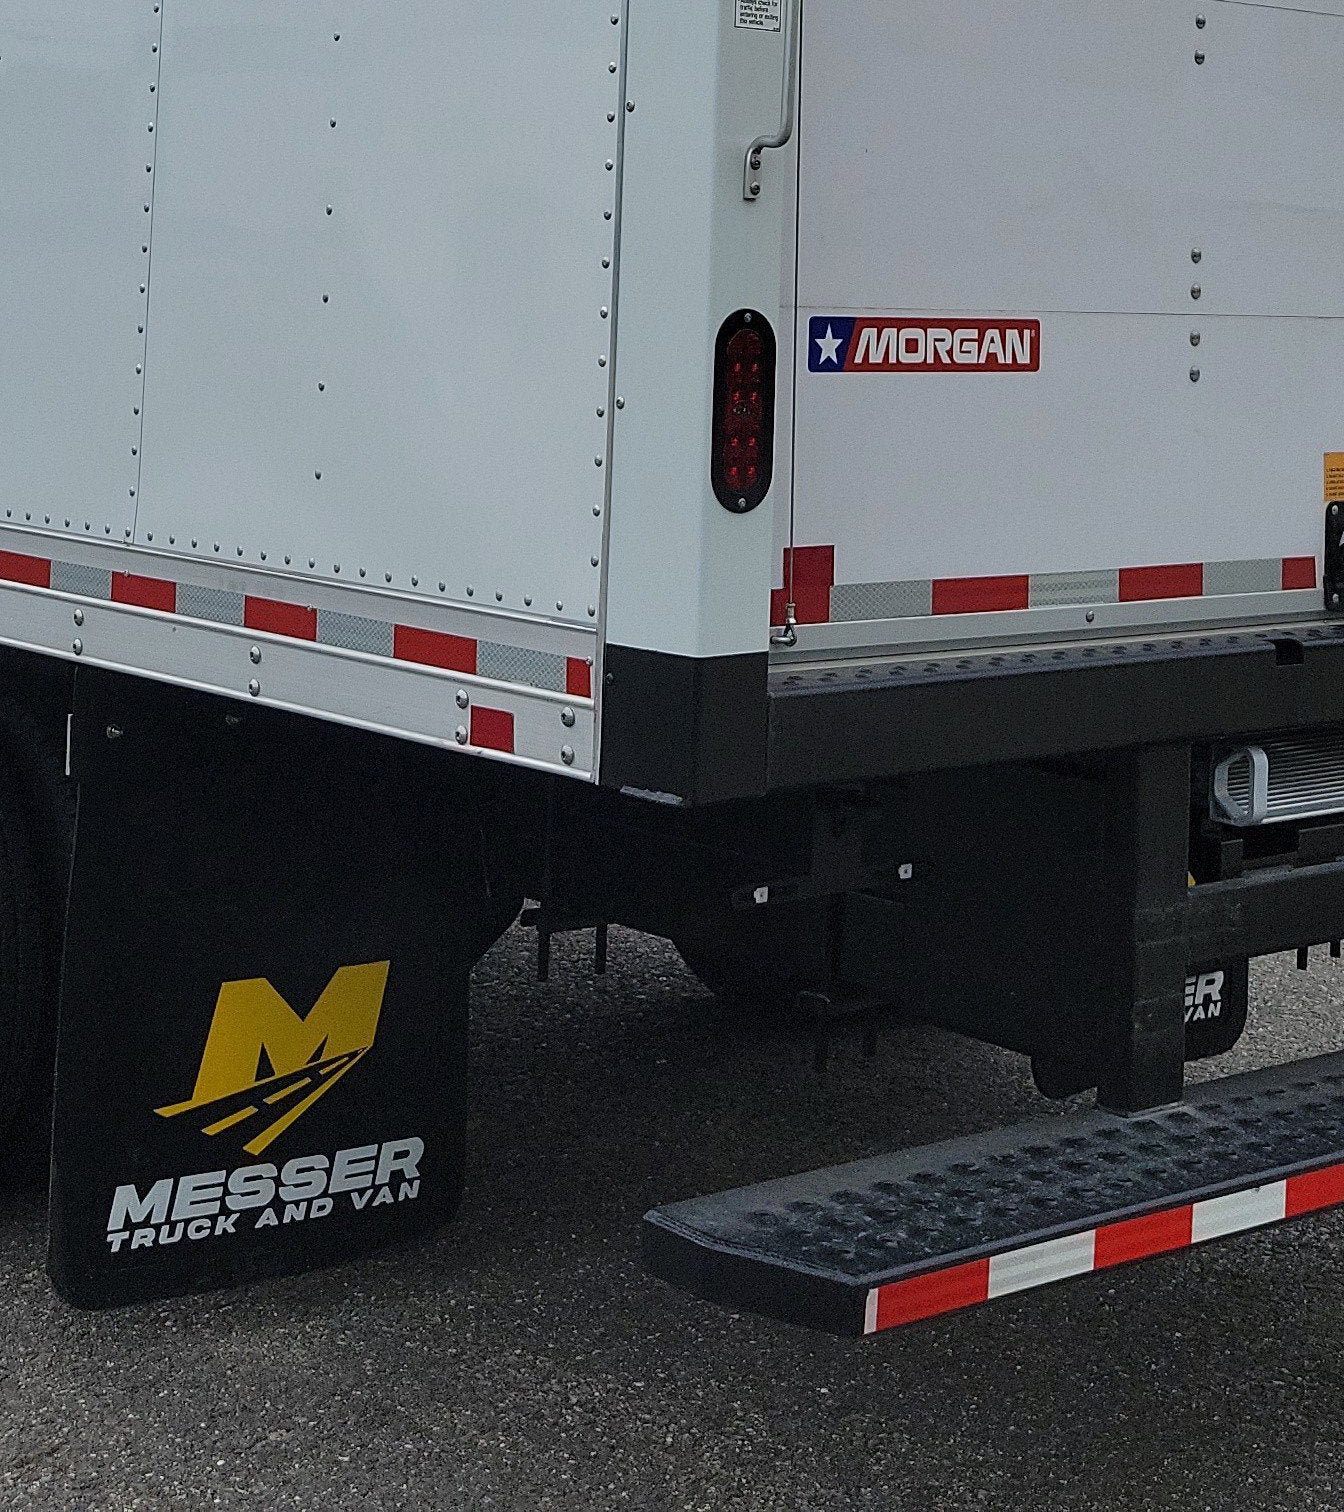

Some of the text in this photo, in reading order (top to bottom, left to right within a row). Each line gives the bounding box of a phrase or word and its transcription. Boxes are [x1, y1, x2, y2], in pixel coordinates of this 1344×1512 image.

[853, 327, 1031, 364] MORGAN
[106, 1137, 425, 1232] MESSER
[106, 1179, 421, 1253] TRUCK AND VAN
